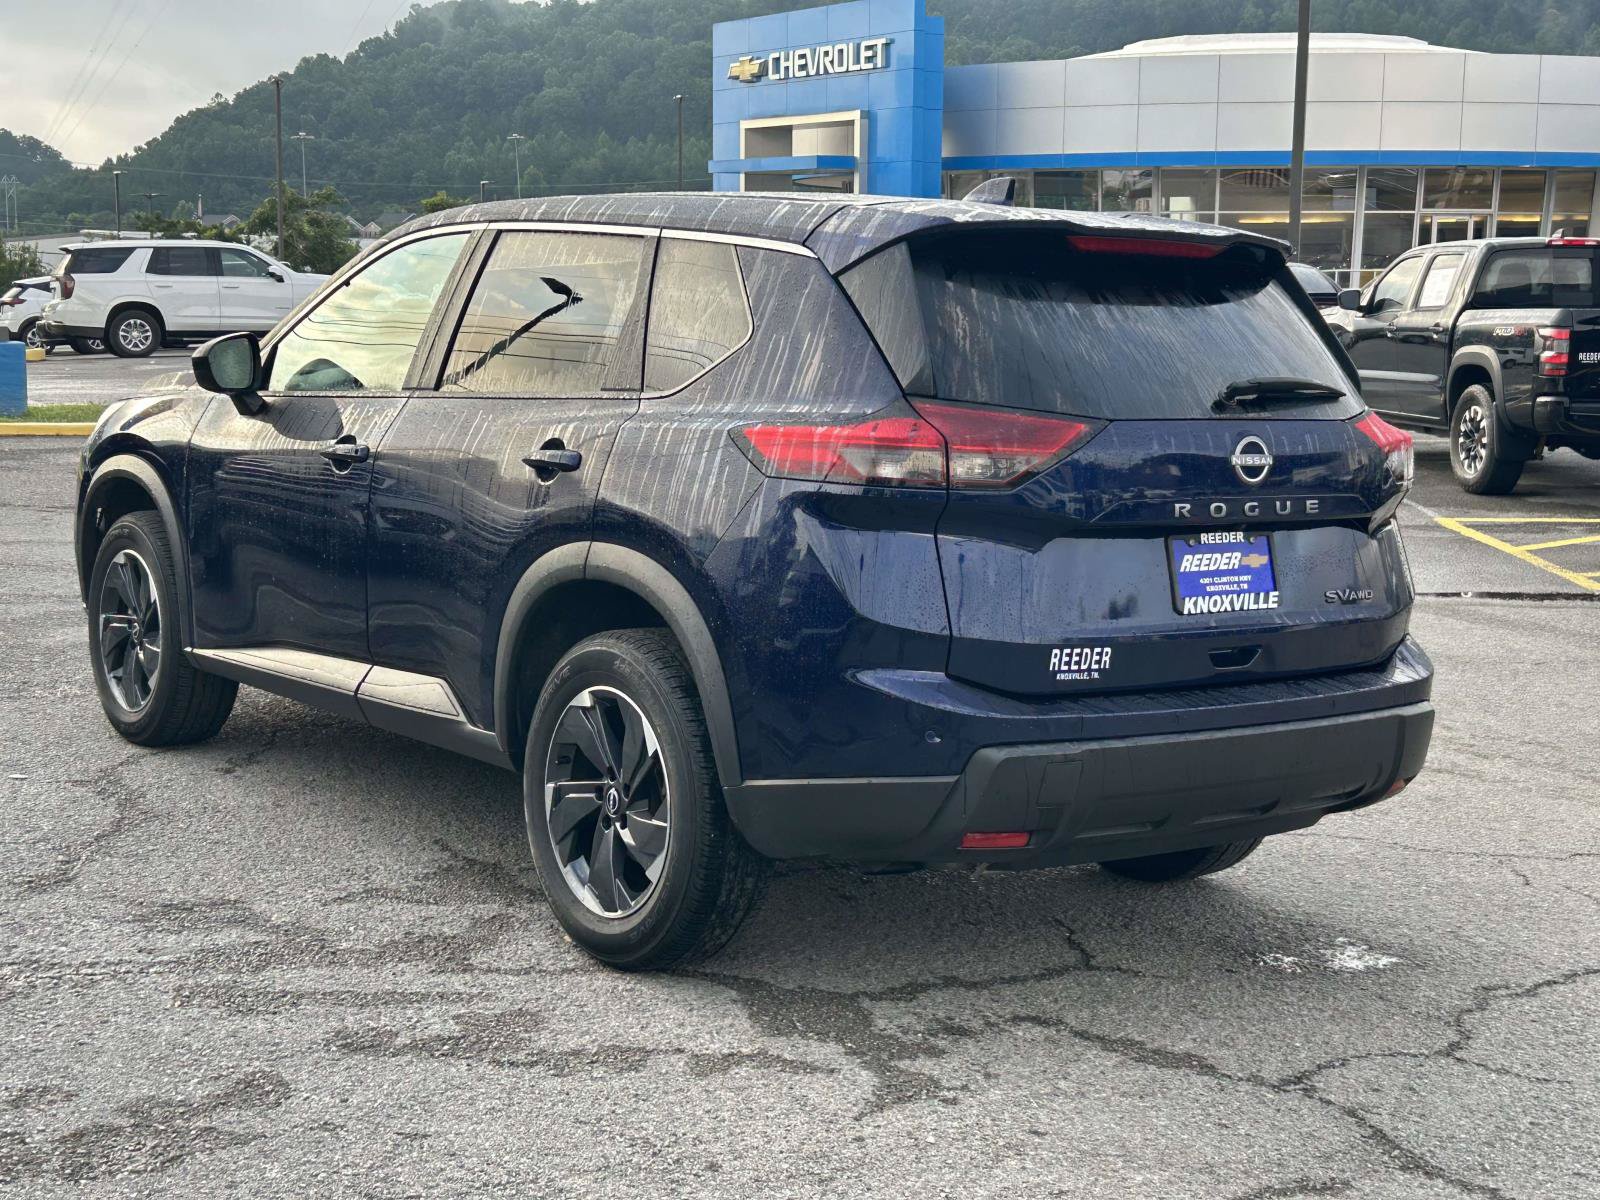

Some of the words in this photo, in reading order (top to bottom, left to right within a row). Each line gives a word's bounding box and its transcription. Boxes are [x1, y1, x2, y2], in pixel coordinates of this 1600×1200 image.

[768, 37, 890, 80] CHEVROLET
[1232, 455, 1273, 465] NISSAN
[1174, 499, 1319, 518] ROGUE
[1200, 531, 1245, 544] REEDER
[1180, 552, 1242, 572] REEDER
[1183, 591, 1279, 615] KNOXVILLE
[1049, 647, 1112, 671] REEDER
